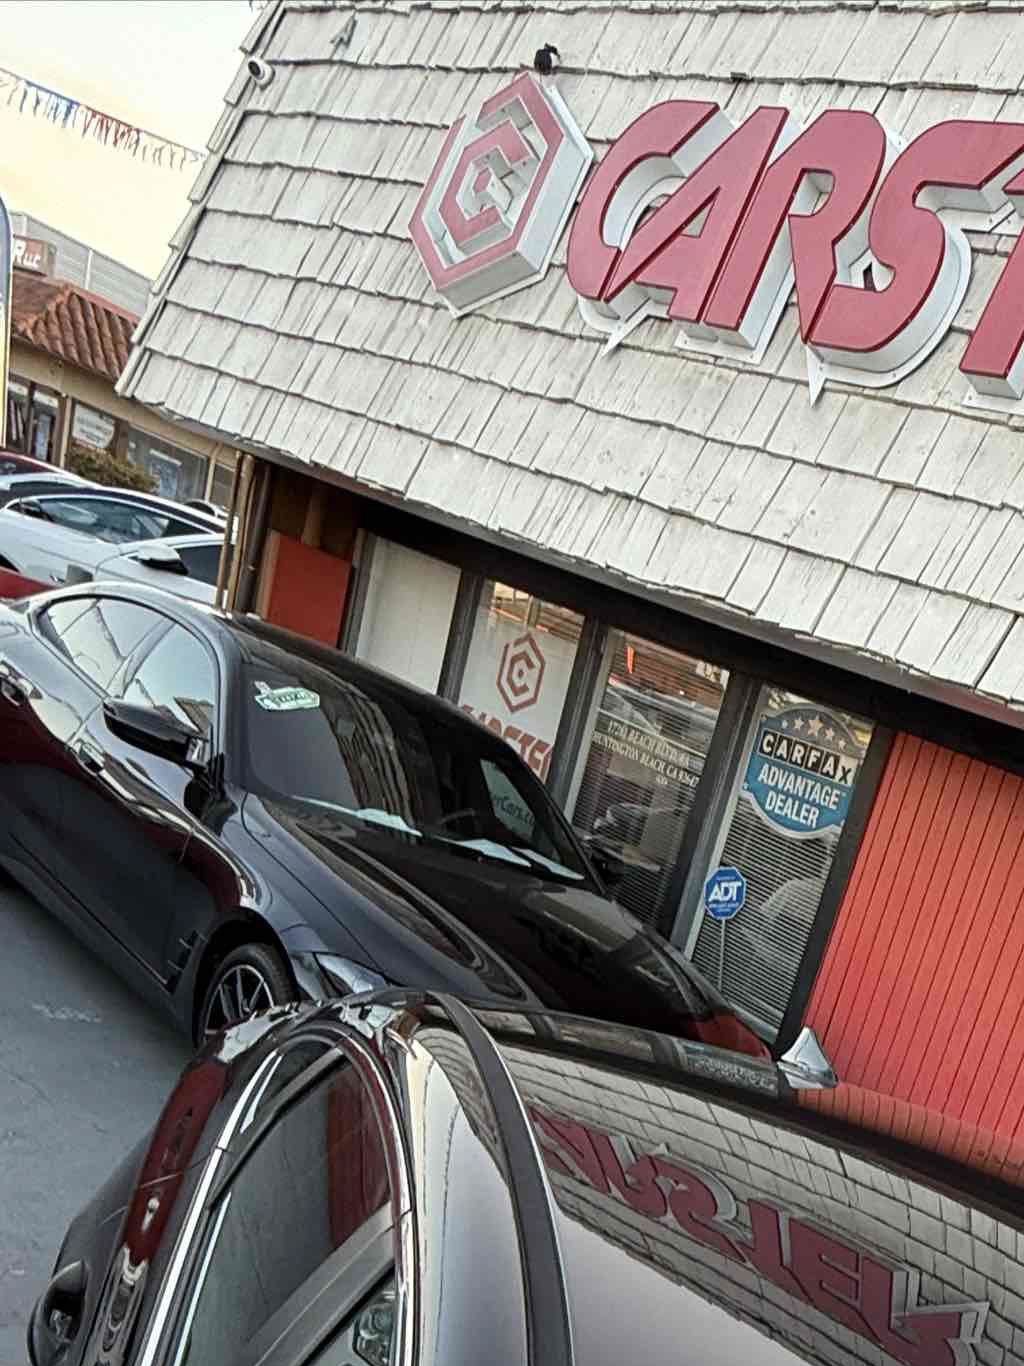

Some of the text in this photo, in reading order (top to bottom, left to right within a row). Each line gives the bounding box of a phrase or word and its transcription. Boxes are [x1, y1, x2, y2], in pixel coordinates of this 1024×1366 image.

[761, 732, 852, 785] CARFAX
[758, 763, 841, 810] ADVANTAGE
[765, 790, 819, 828] DEALER
[708, 881, 742, 902] ADT
